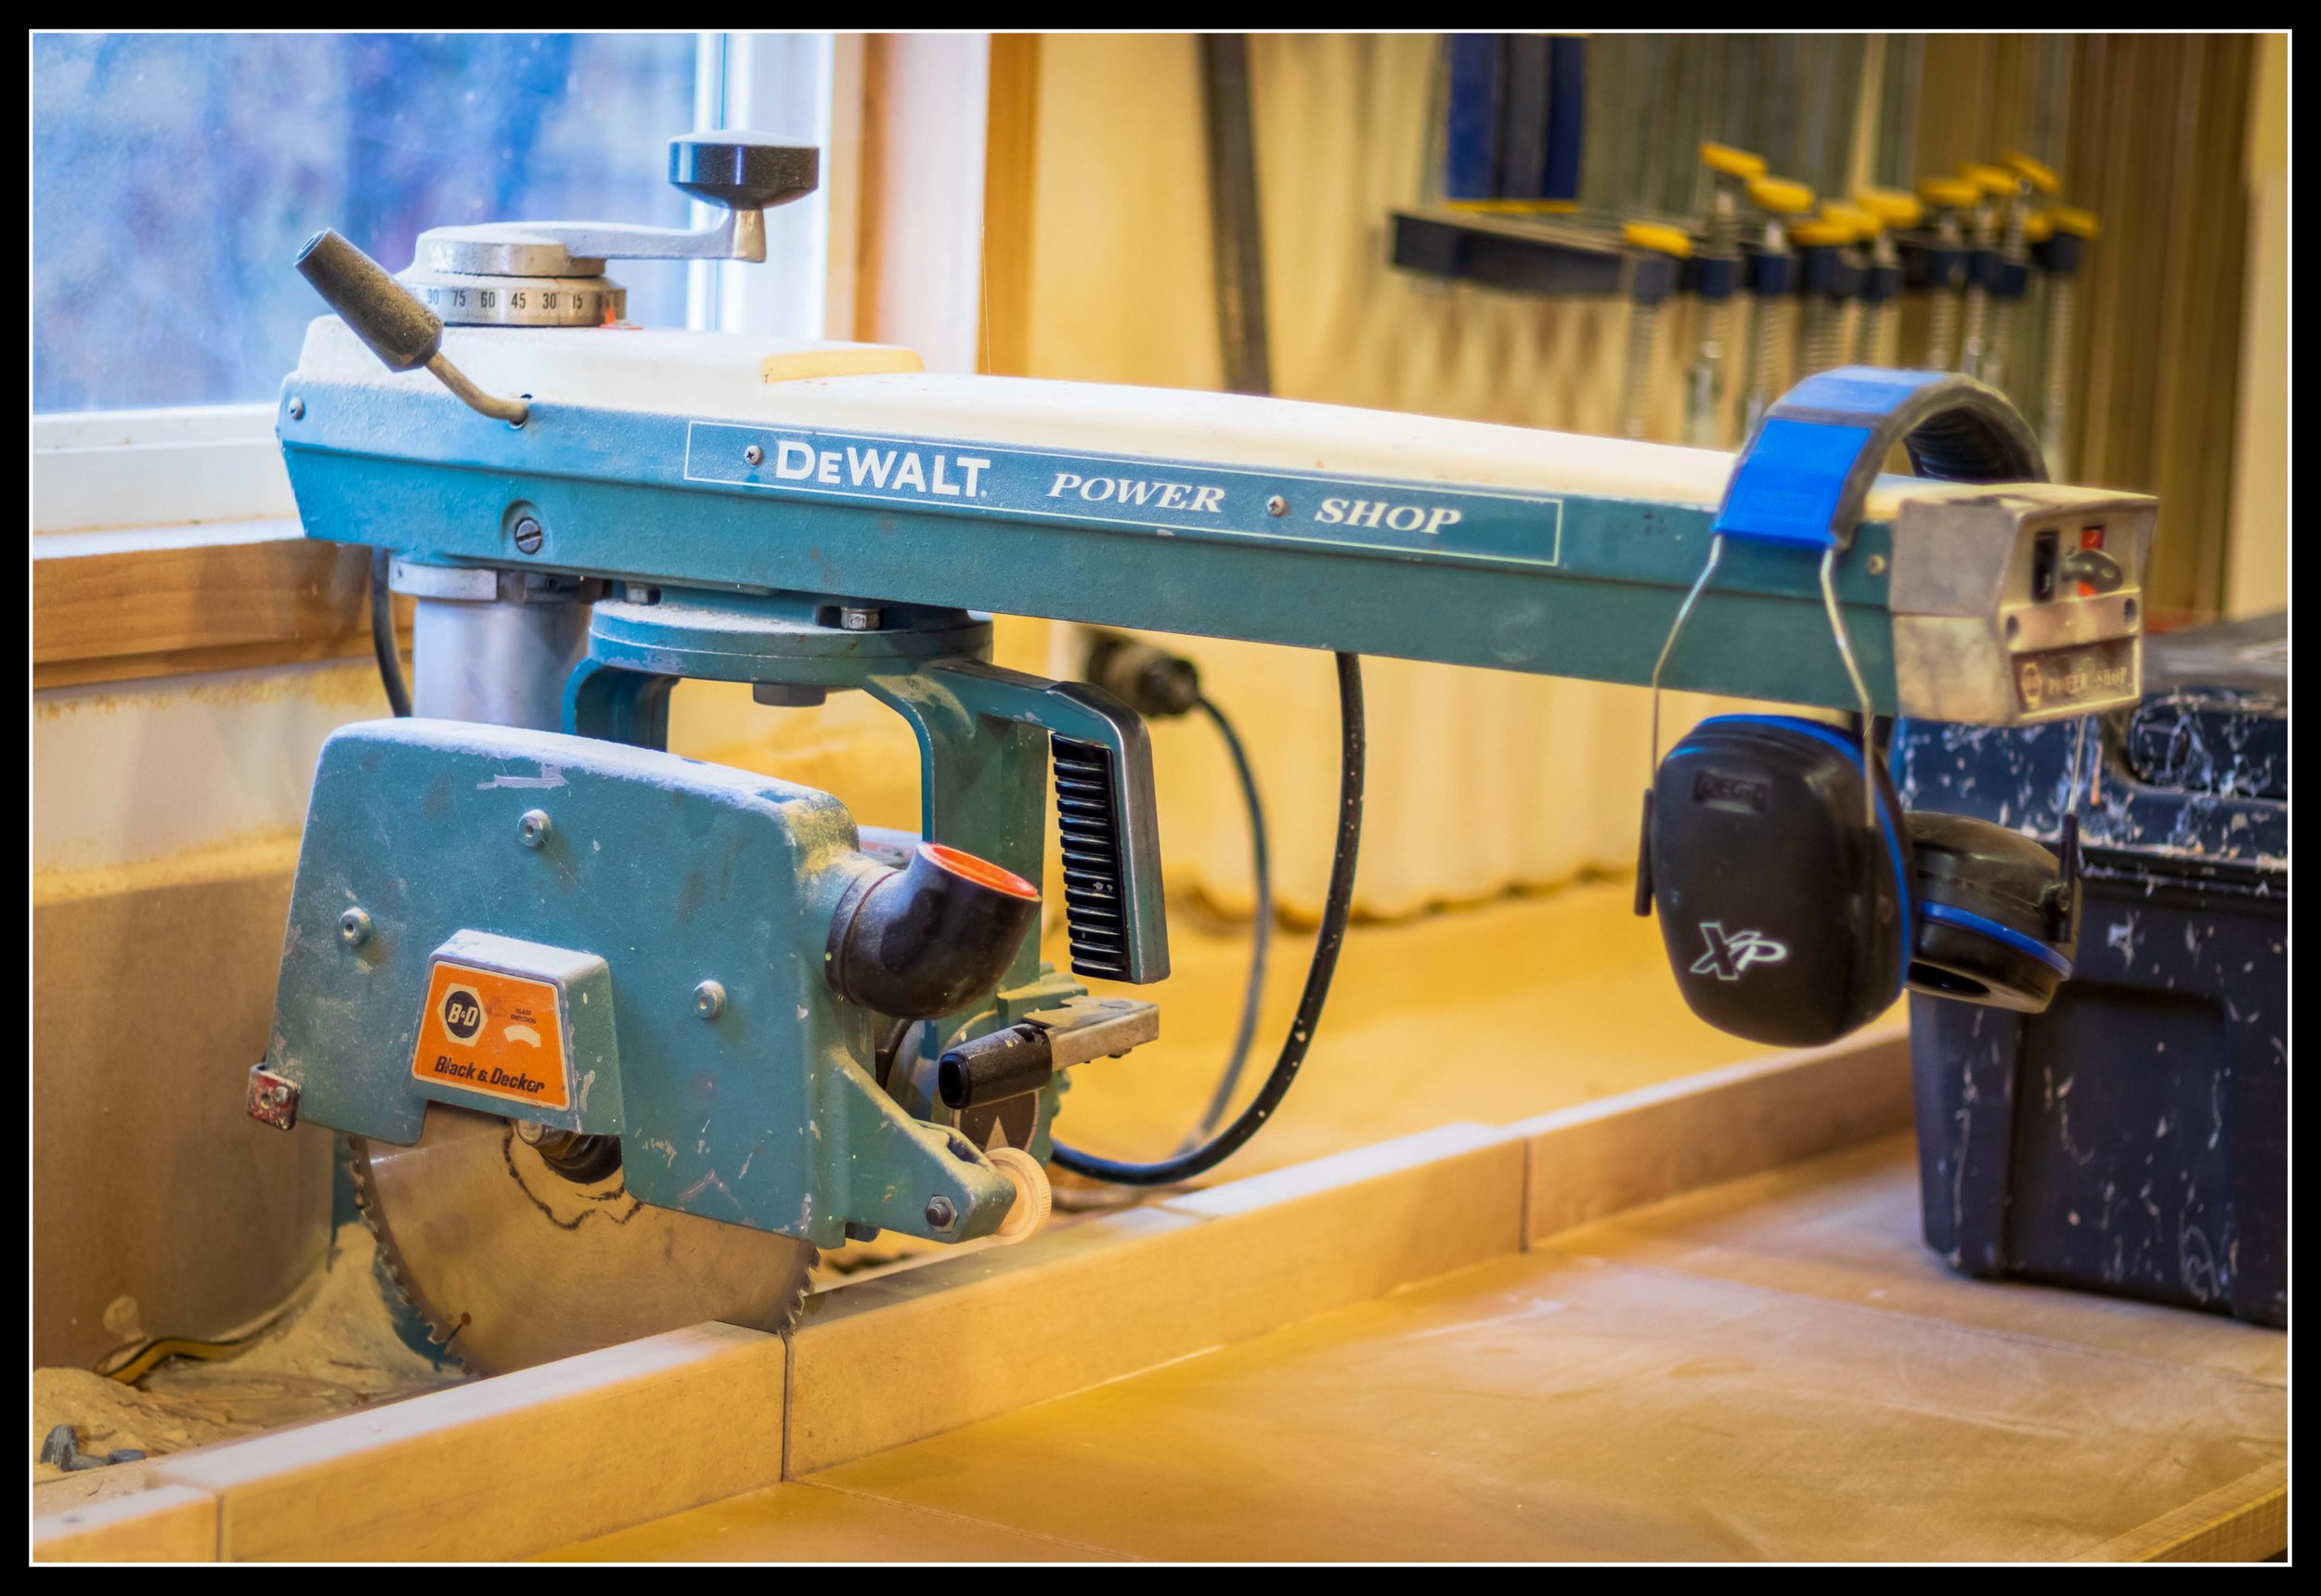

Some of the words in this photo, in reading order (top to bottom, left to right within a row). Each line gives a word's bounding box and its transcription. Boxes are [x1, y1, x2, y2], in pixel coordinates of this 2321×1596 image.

[453, 290, 467, 307] 75
[481, 292, 496, 308] 60
[511, 292, 526, 309] 45
[542, 292, 557, 309] 30
[572, 293, 584, 309] 15
[1044, 473, 1225, 513] POWER
[1315, 498, 1461, 534] SHOP
[1690, 922, 1787, 980] XP
[447, 1004, 478, 1026] B&D
[434, 1056, 475, 1079] Black
[477, 1070, 487, 1083] &
[490, 1068, 545, 1093] Decker
